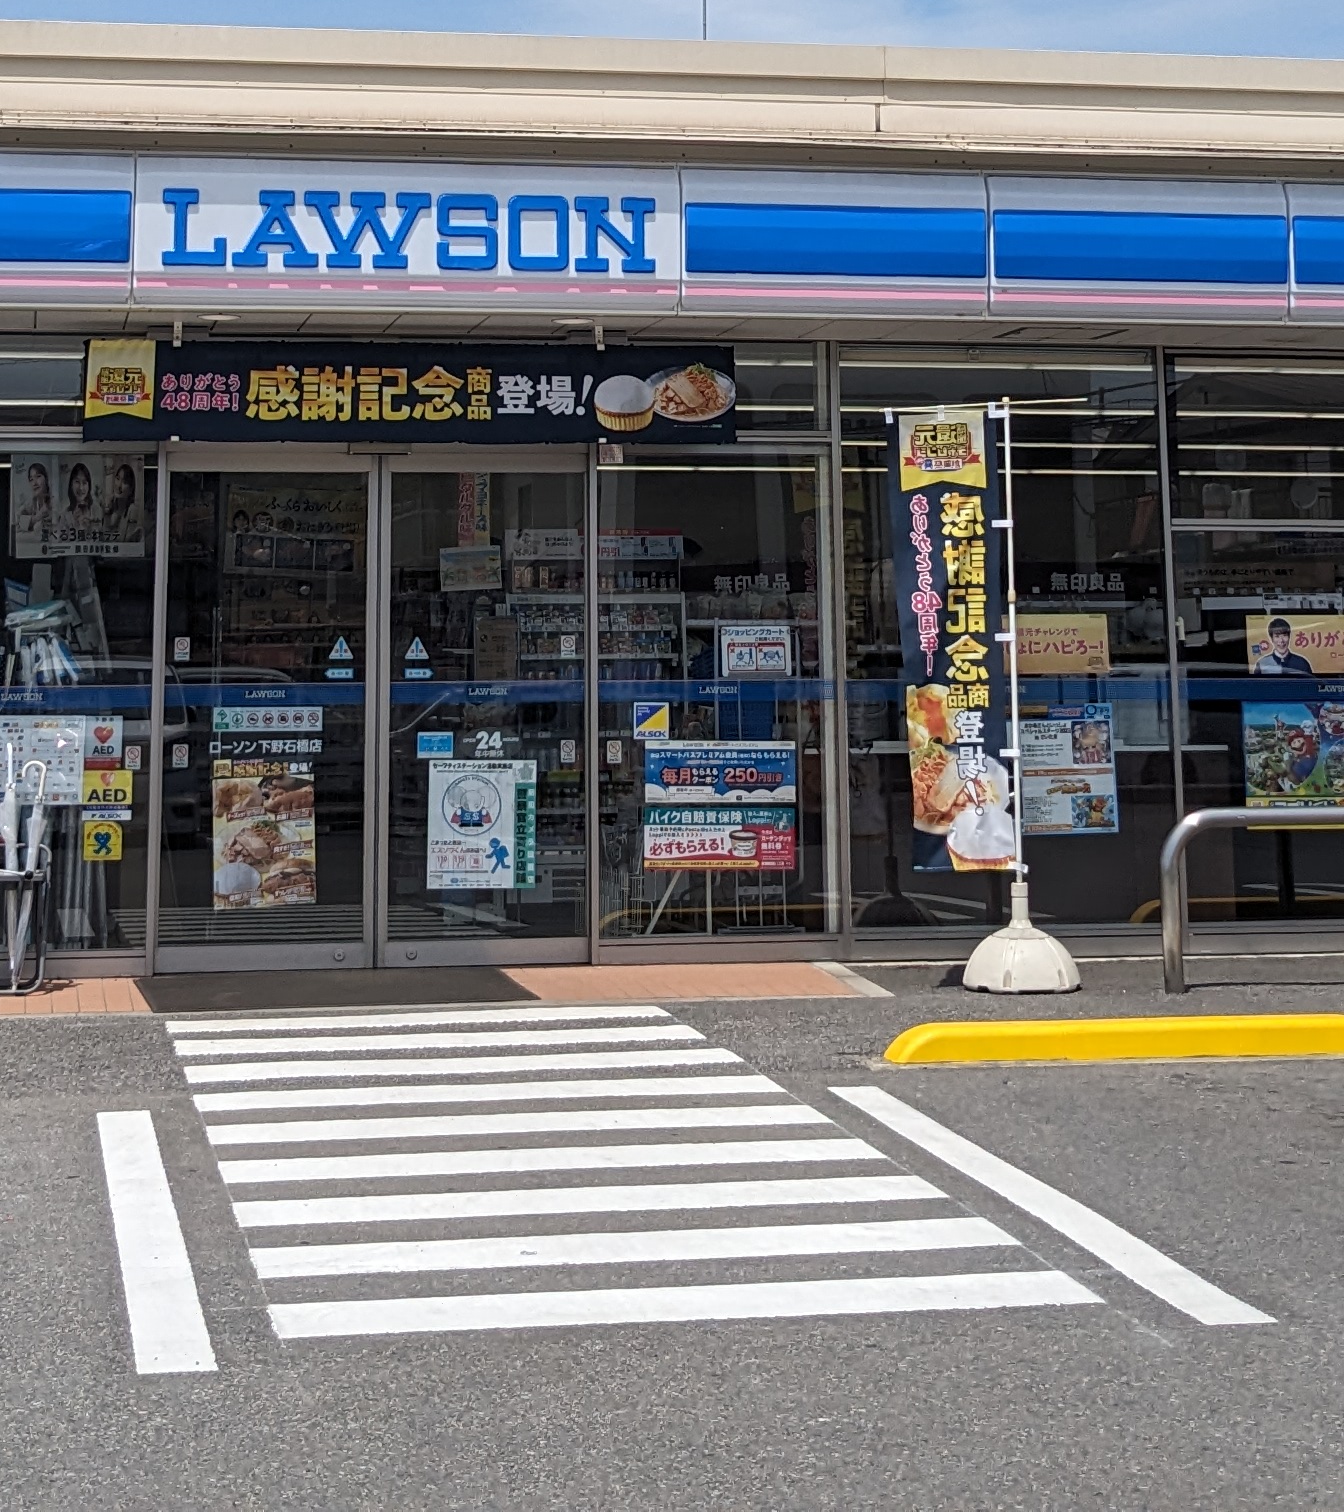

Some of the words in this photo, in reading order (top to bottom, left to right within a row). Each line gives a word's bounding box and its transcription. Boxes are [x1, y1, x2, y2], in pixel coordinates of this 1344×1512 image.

[161, 187, 656, 273] LAWSON
[161, 373, 241, 391] ありがとう
[161, 392, 241, 411] 48周年!
[713, 573, 791, 594] 無印良品
[1050, 571, 1125, 593] 無印良品
[1006, 639, 1105, 655] ょにハピろー!
[245, 689, 287, 699] LAWSON
[475, 730, 503, 750] 24
[636, 730, 667, 738] ALSOK
[92, 745, 115, 755] AED
[209, 739, 323, 754] ローソン下野石橋店
[662, 767, 692, 785] 毎月
[87, 788, 128, 803] AED
[649, 810, 743, 825] バイク自賠責保険
[649, 837, 726, 856] 必ずもらえる!
